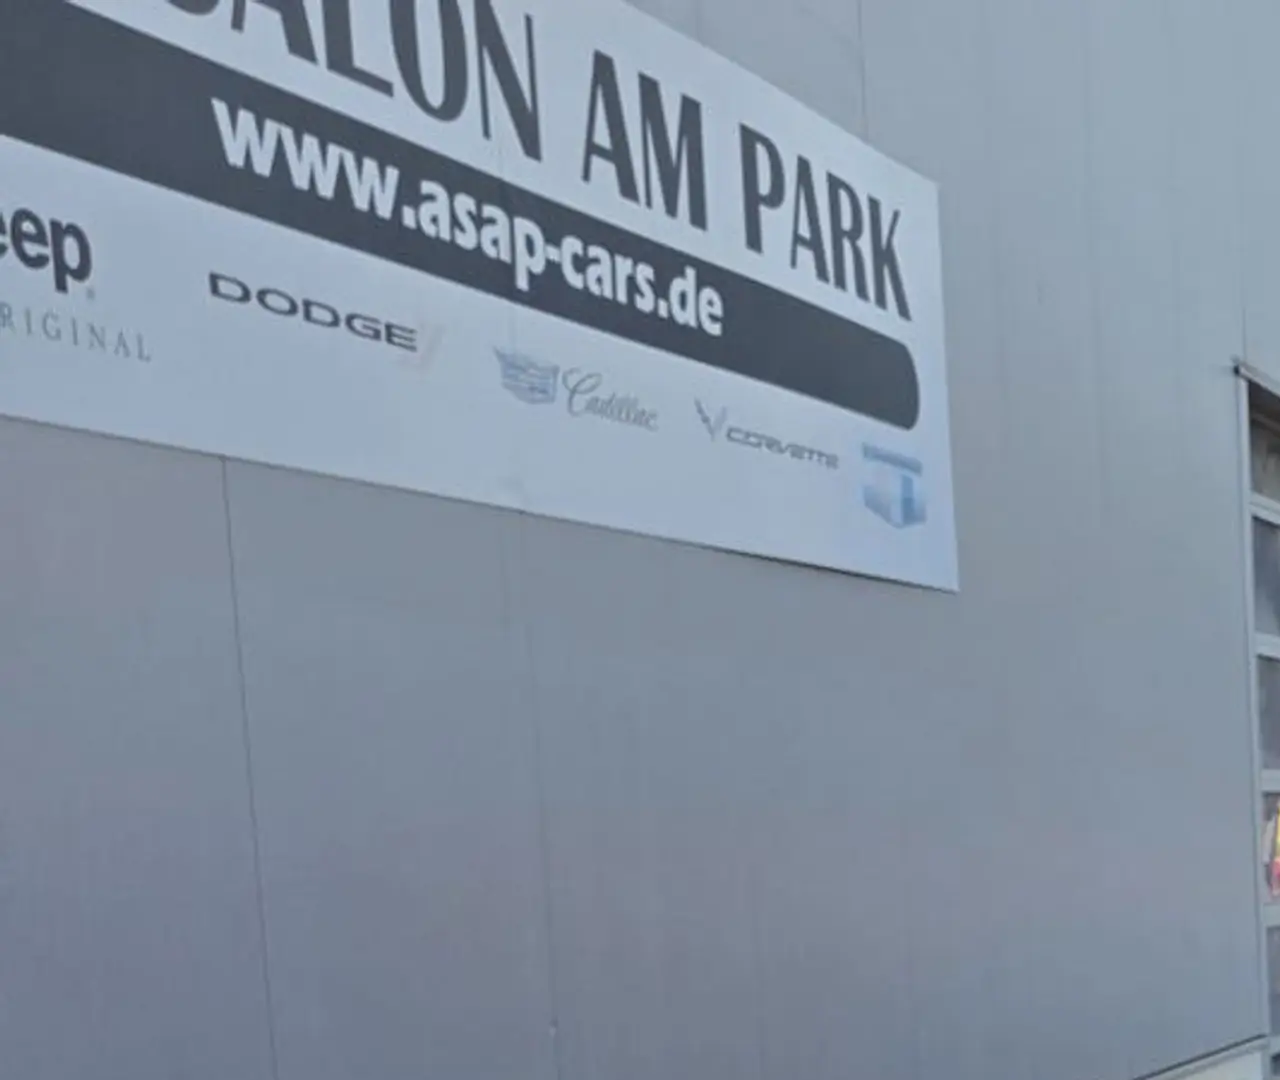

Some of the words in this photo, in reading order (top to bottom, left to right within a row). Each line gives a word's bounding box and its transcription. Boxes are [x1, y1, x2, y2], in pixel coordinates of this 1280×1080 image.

[161, 0, 542, 163] LON
[581, 48, 707, 231] AM
[739, 122, 912, 321] PARK
[211, 98, 724, 336] www.asap-cars.de
[0, 207, 93, 294] ep
[209, 272, 418, 352] DODGE
